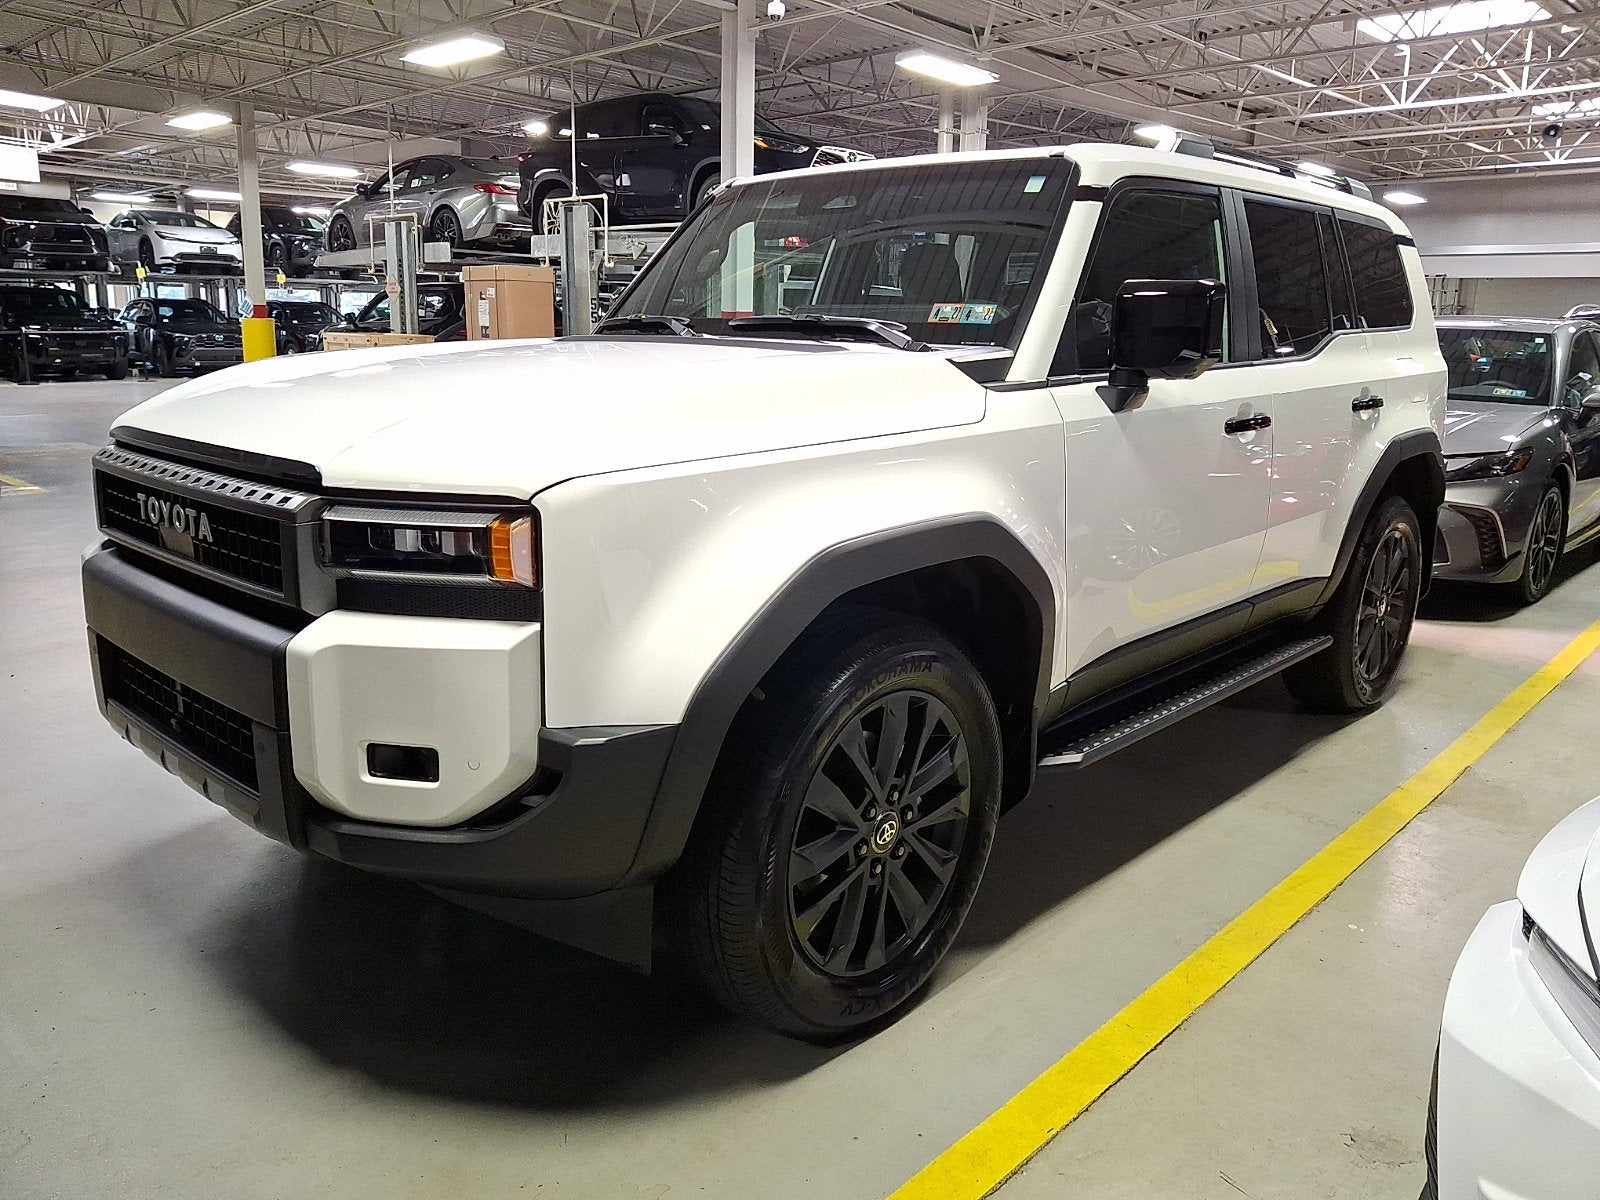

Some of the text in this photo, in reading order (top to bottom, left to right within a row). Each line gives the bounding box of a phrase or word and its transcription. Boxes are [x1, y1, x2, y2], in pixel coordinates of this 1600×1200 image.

[590, 298, 597, 310] 5
[590, 311, 598, 323] 5
[136, 492, 214, 543] TOYOTA
